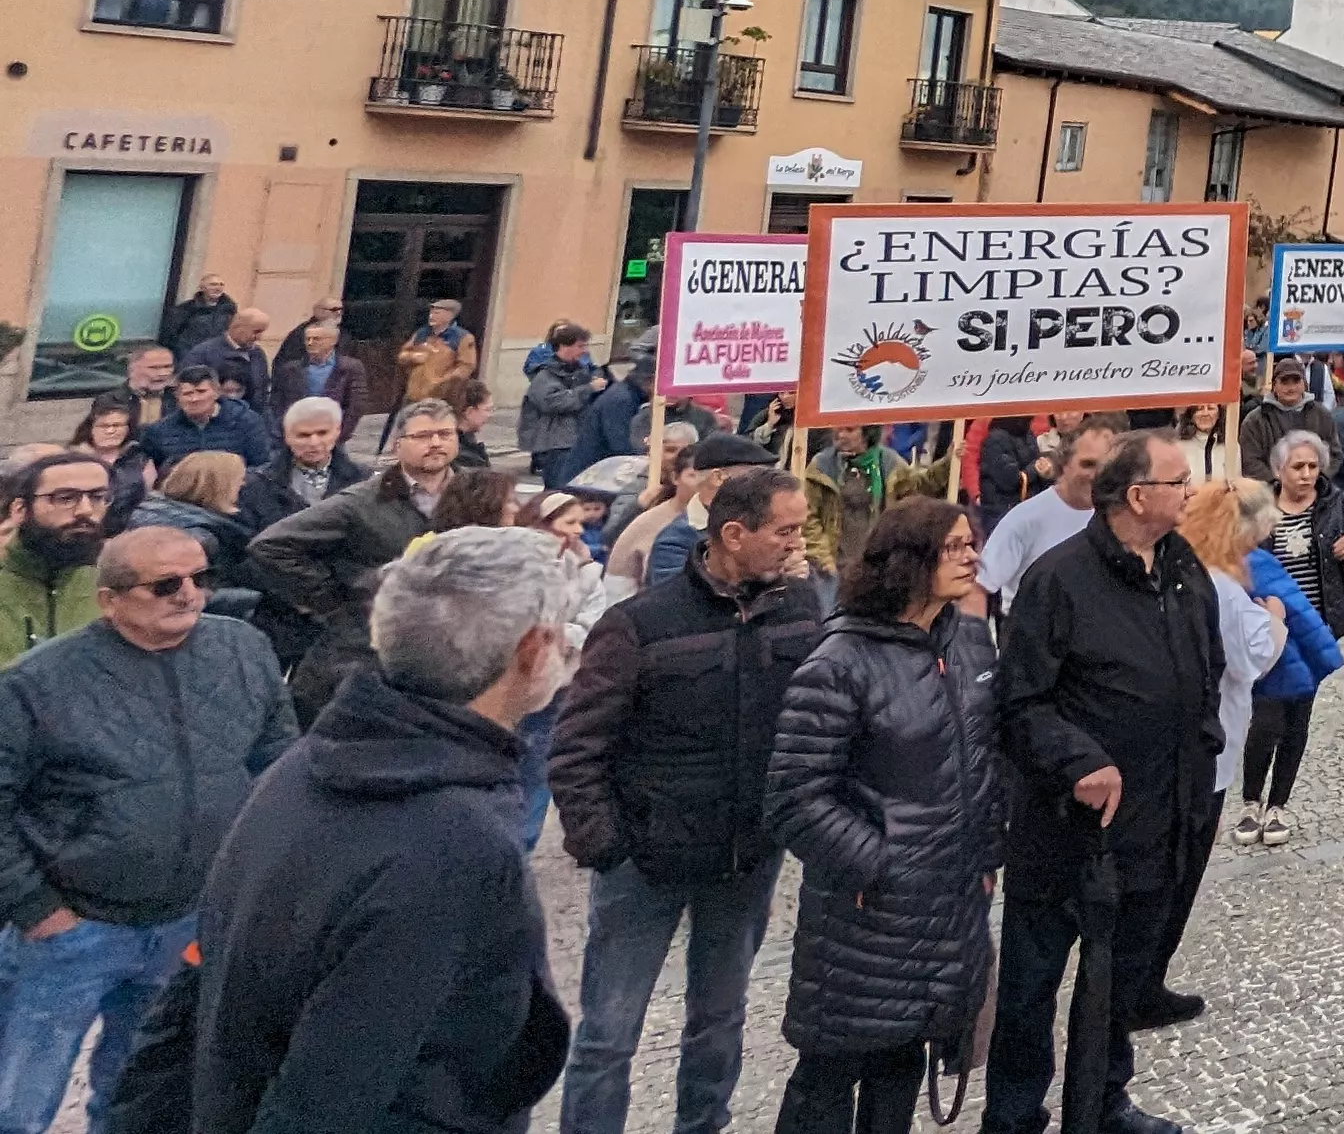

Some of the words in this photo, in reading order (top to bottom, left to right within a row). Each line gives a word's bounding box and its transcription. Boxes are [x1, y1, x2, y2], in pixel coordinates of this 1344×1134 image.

[63, 132, 213, 154] CAFETERIA
[840, 221, 1211, 273] ¿ENERGÍAS
[688, 259, 807, 294] ¿GENERA
[868, 266, 1184, 303] LIMPIAS?
[1028, 304, 1214, 349] PERO...
[684, 343, 711, 365] LA
[715, 341, 788, 363] FUENTE
[949, 368, 986, 388] sin
[974, 361, 1047, 397] joder
[1052, 362, 1134, 382] nuestro
[1141, 360, 1211, 379] Bierzo
